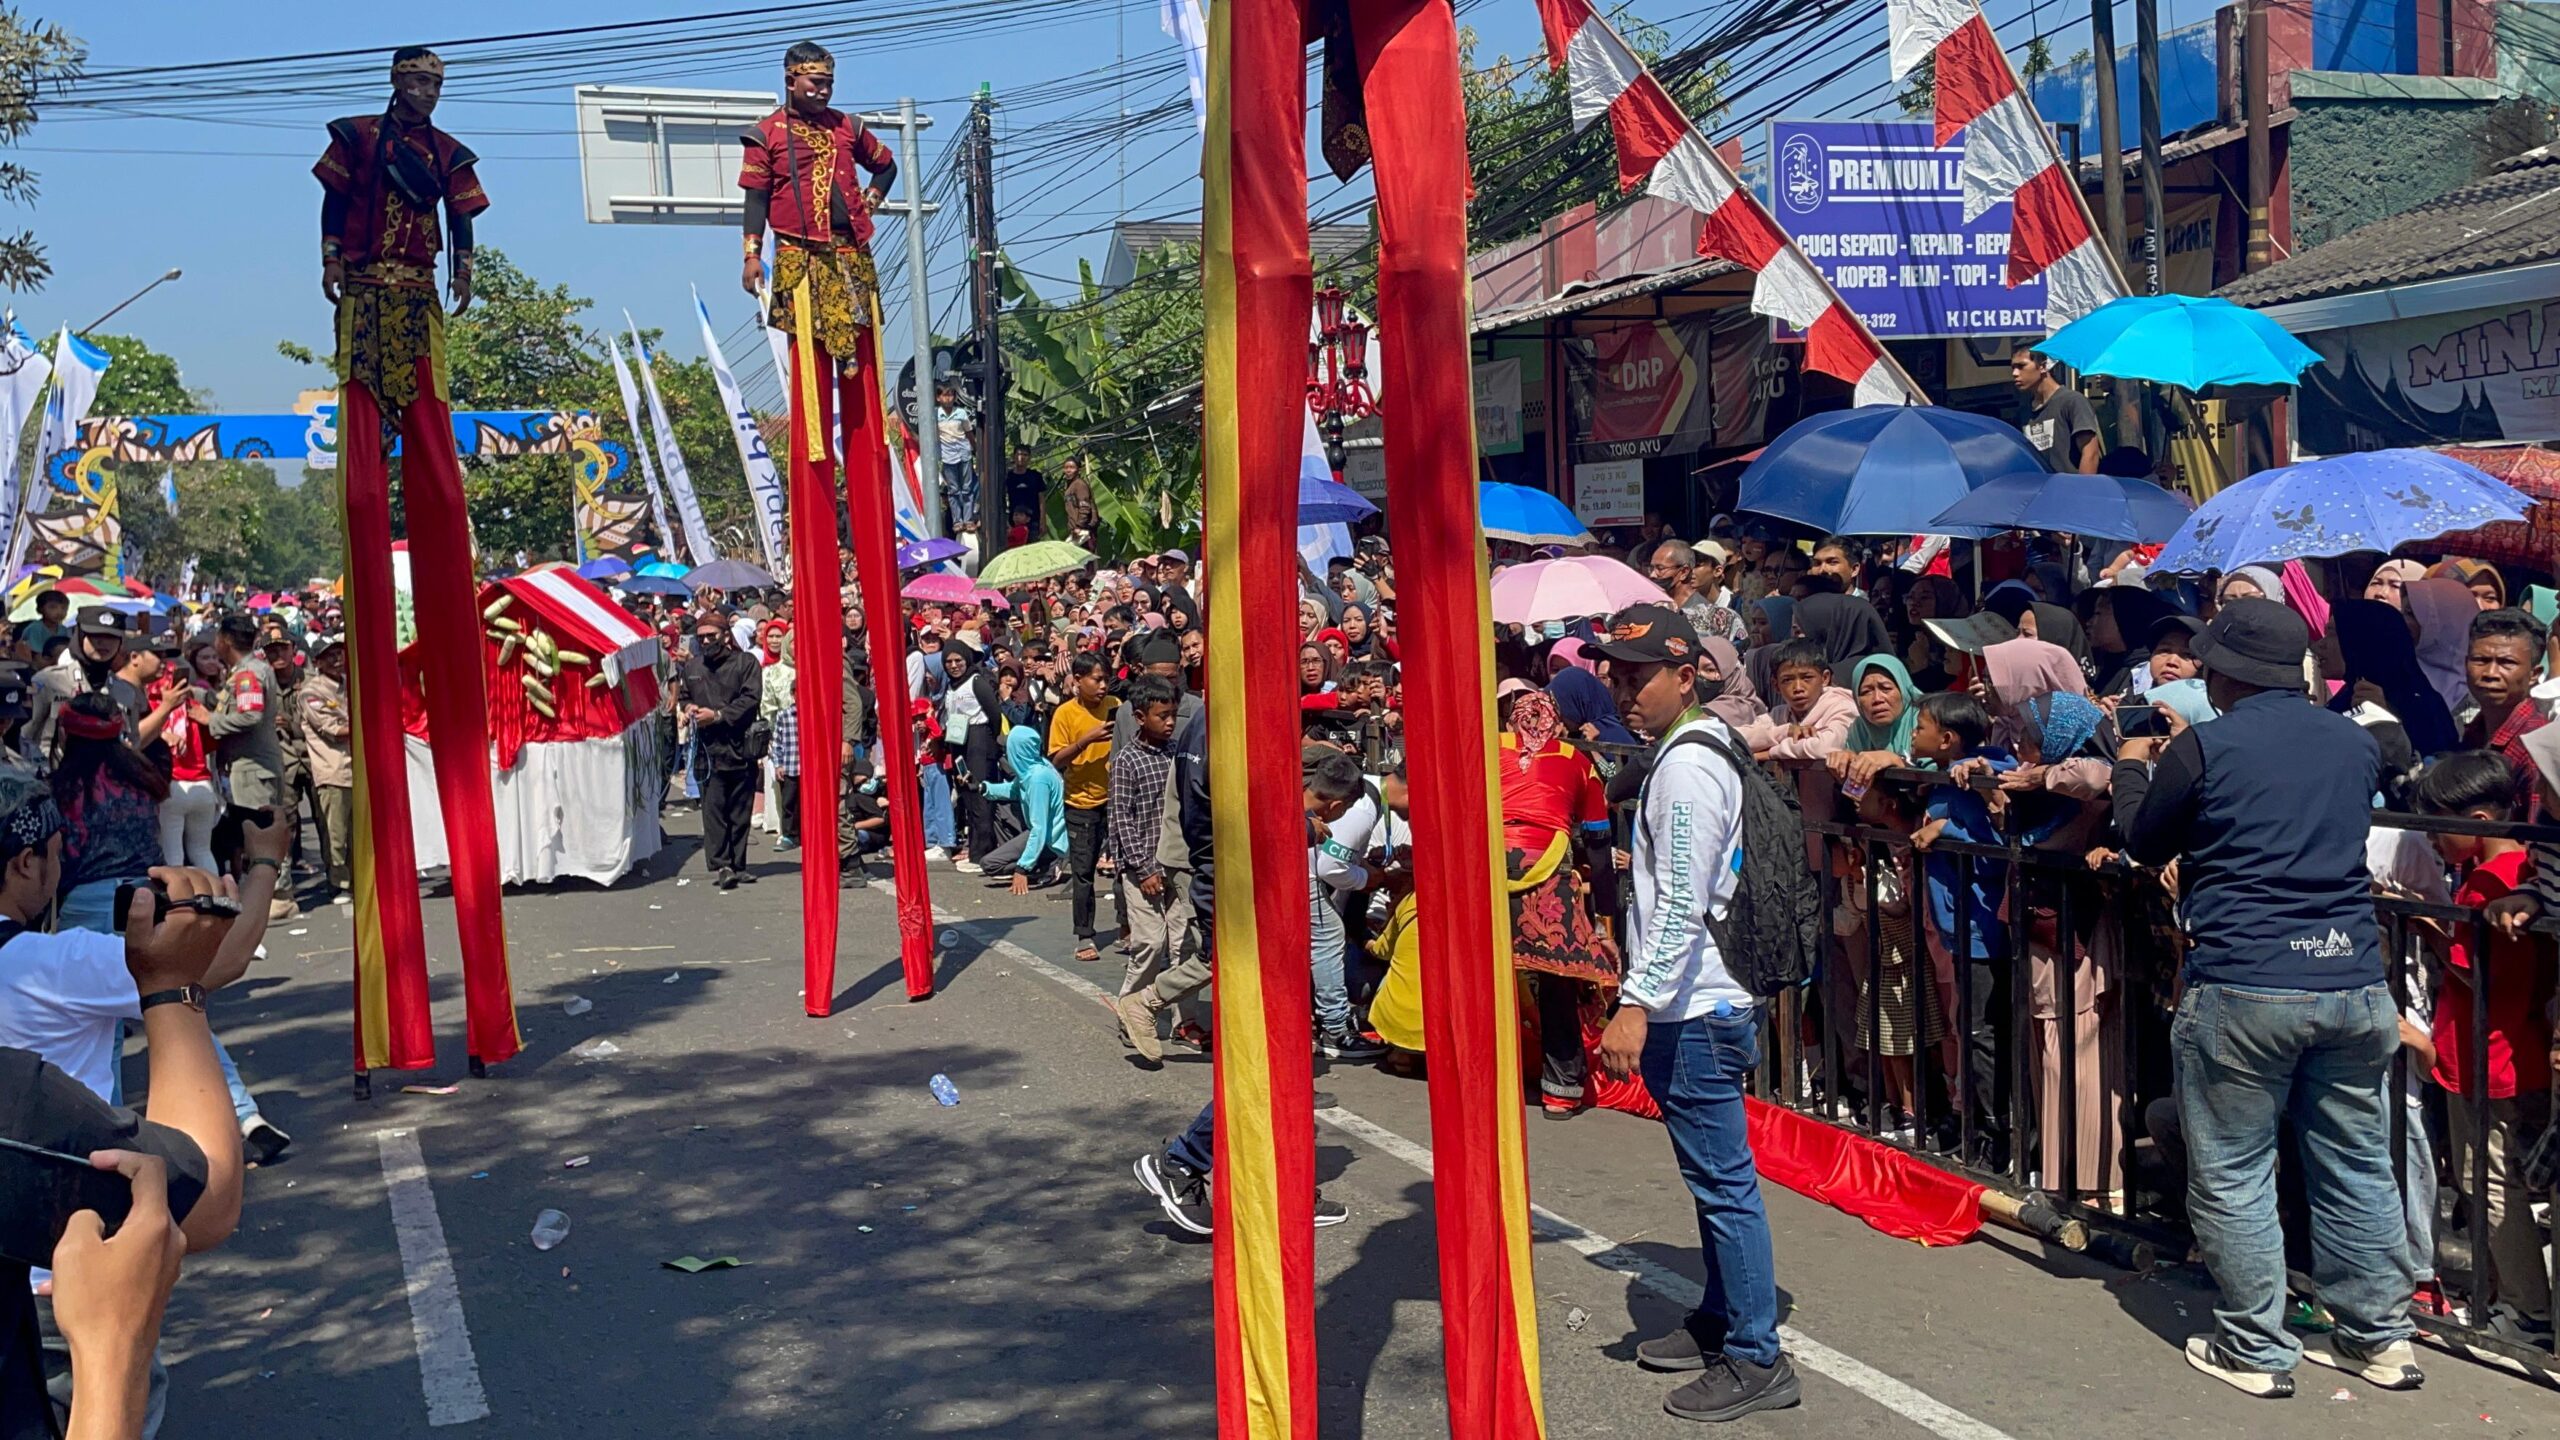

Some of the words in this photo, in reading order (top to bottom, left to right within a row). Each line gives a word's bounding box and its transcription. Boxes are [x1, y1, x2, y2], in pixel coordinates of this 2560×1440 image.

[1829, 159, 1939, 191] PREMIUM
[1797, 234, 1836, 257] CUCI
[1840, 233, 1898, 257] SEPATU
[1910, 233, 1963, 256] REPAIR
[1836, 265, 1888, 288] KOPER
[1900, 265, 1940, 288] HELM
[1952, 264, 1987, 287] TOPI
[1622, 357, 1664, 392] DRP
[1609, 442, 1637, 458] TOKO
[1640, 439, 1661, 454] AYU
[1328, 843, 1353, 861] CRE
[2289, 935, 2324, 957] triple
[2313, 944, 2355, 958] outdoor
